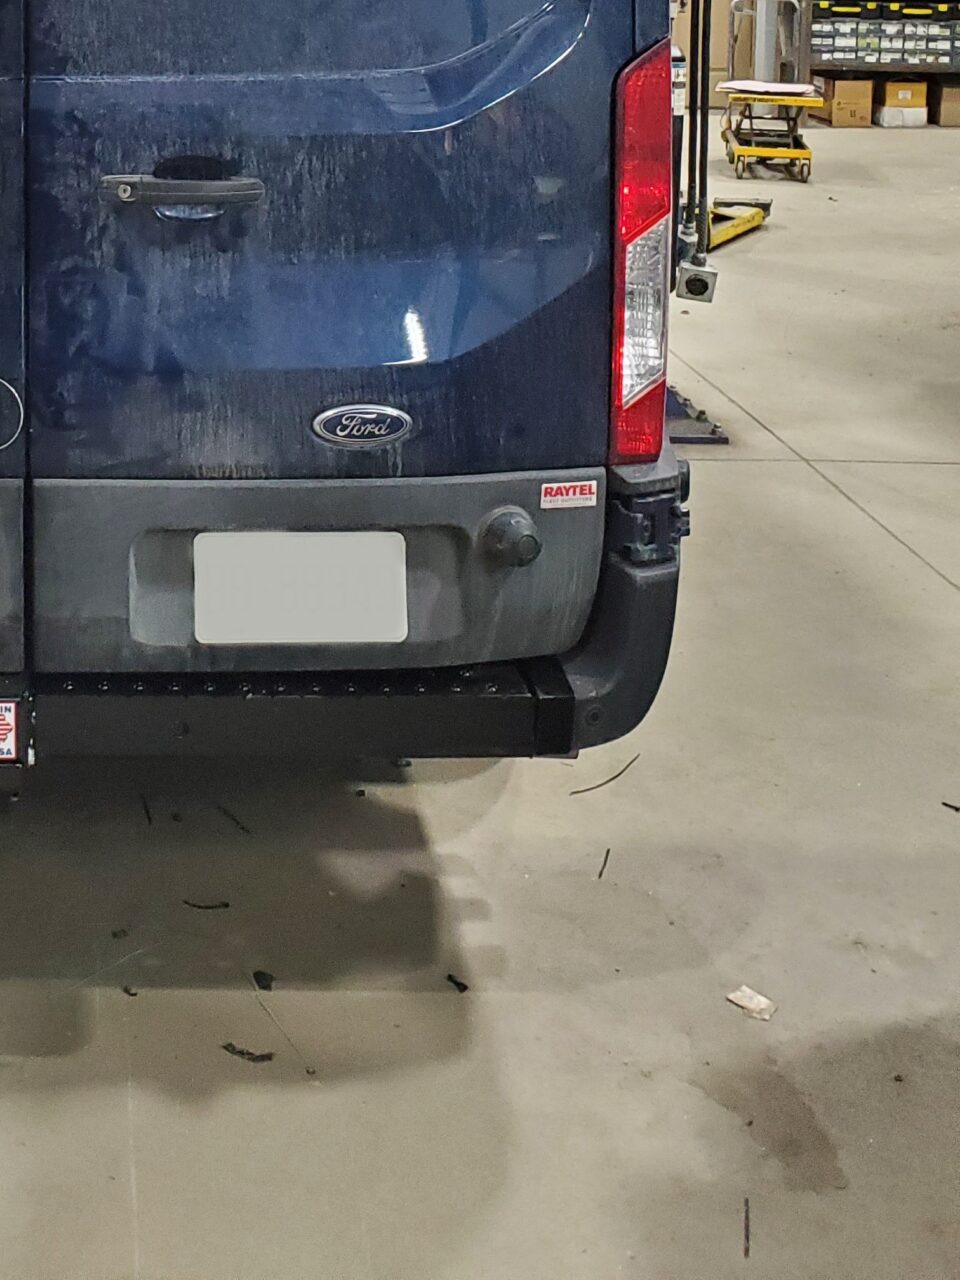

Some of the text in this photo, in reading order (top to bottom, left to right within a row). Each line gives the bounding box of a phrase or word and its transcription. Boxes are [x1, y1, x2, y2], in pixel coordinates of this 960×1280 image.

[336, 413, 391, 437] Ford
[543, 483, 595, 498] RAYTEL
[0, 705, 12, 713] IN
